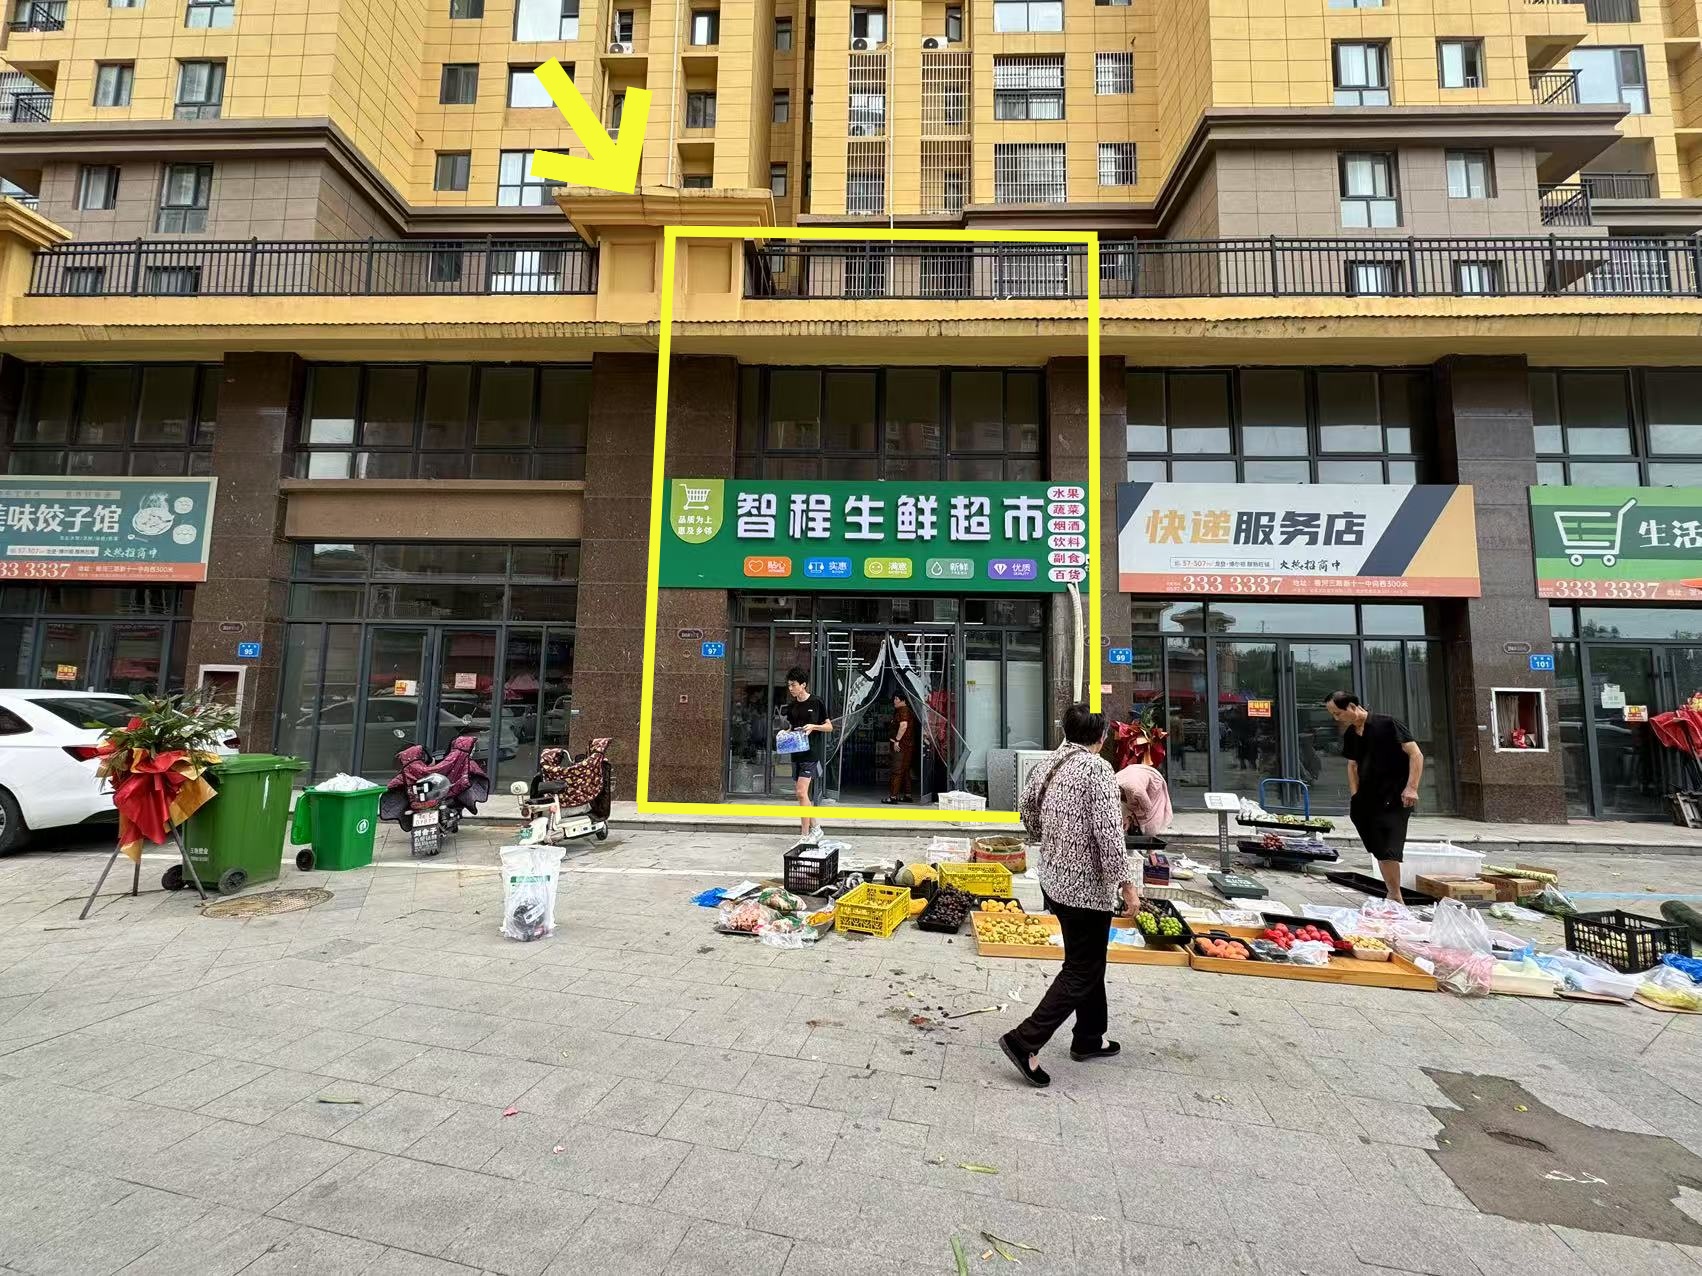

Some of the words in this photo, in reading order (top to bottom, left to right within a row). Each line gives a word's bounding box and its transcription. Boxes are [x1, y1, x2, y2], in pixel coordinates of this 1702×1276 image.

[1053, 488, 1079, 498] 水果
[1053, 504, 1080, 515] 蔬菜
[0, 503, 122, 533] 味饺子馆
[677, 515, 713, 525] 品质为上
[737, 492, 1045, 541] 智程生鲜超市
[1053, 520, 1080, 531] 烟酒
[1145, 509, 1367, 546] 快递服务店
[1638, 519, 1702, 549] 生活
[1053, 536, 1080, 548] 饮料
[1053, 552, 1080, 564] 副食
[24, 562, 71, 577] 3337
[767, 560, 787, 569] 贴心
[828, 560, 848, 571] 实惠
[887, 561, 908, 571] 满意
[950, 562, 969, 571] 新鲜
[1011, 563, 1031, 572] 优质
[1054, 568, 1081, 580] 百货
[1183, 575, 1223, 592] 333
[1230, 576, 1283, 593] 3337
[1556, 580, 1598, 598] 333
[1604, 581, 1661, 599] 3337
[1116, 654, 1126, 662] 99
